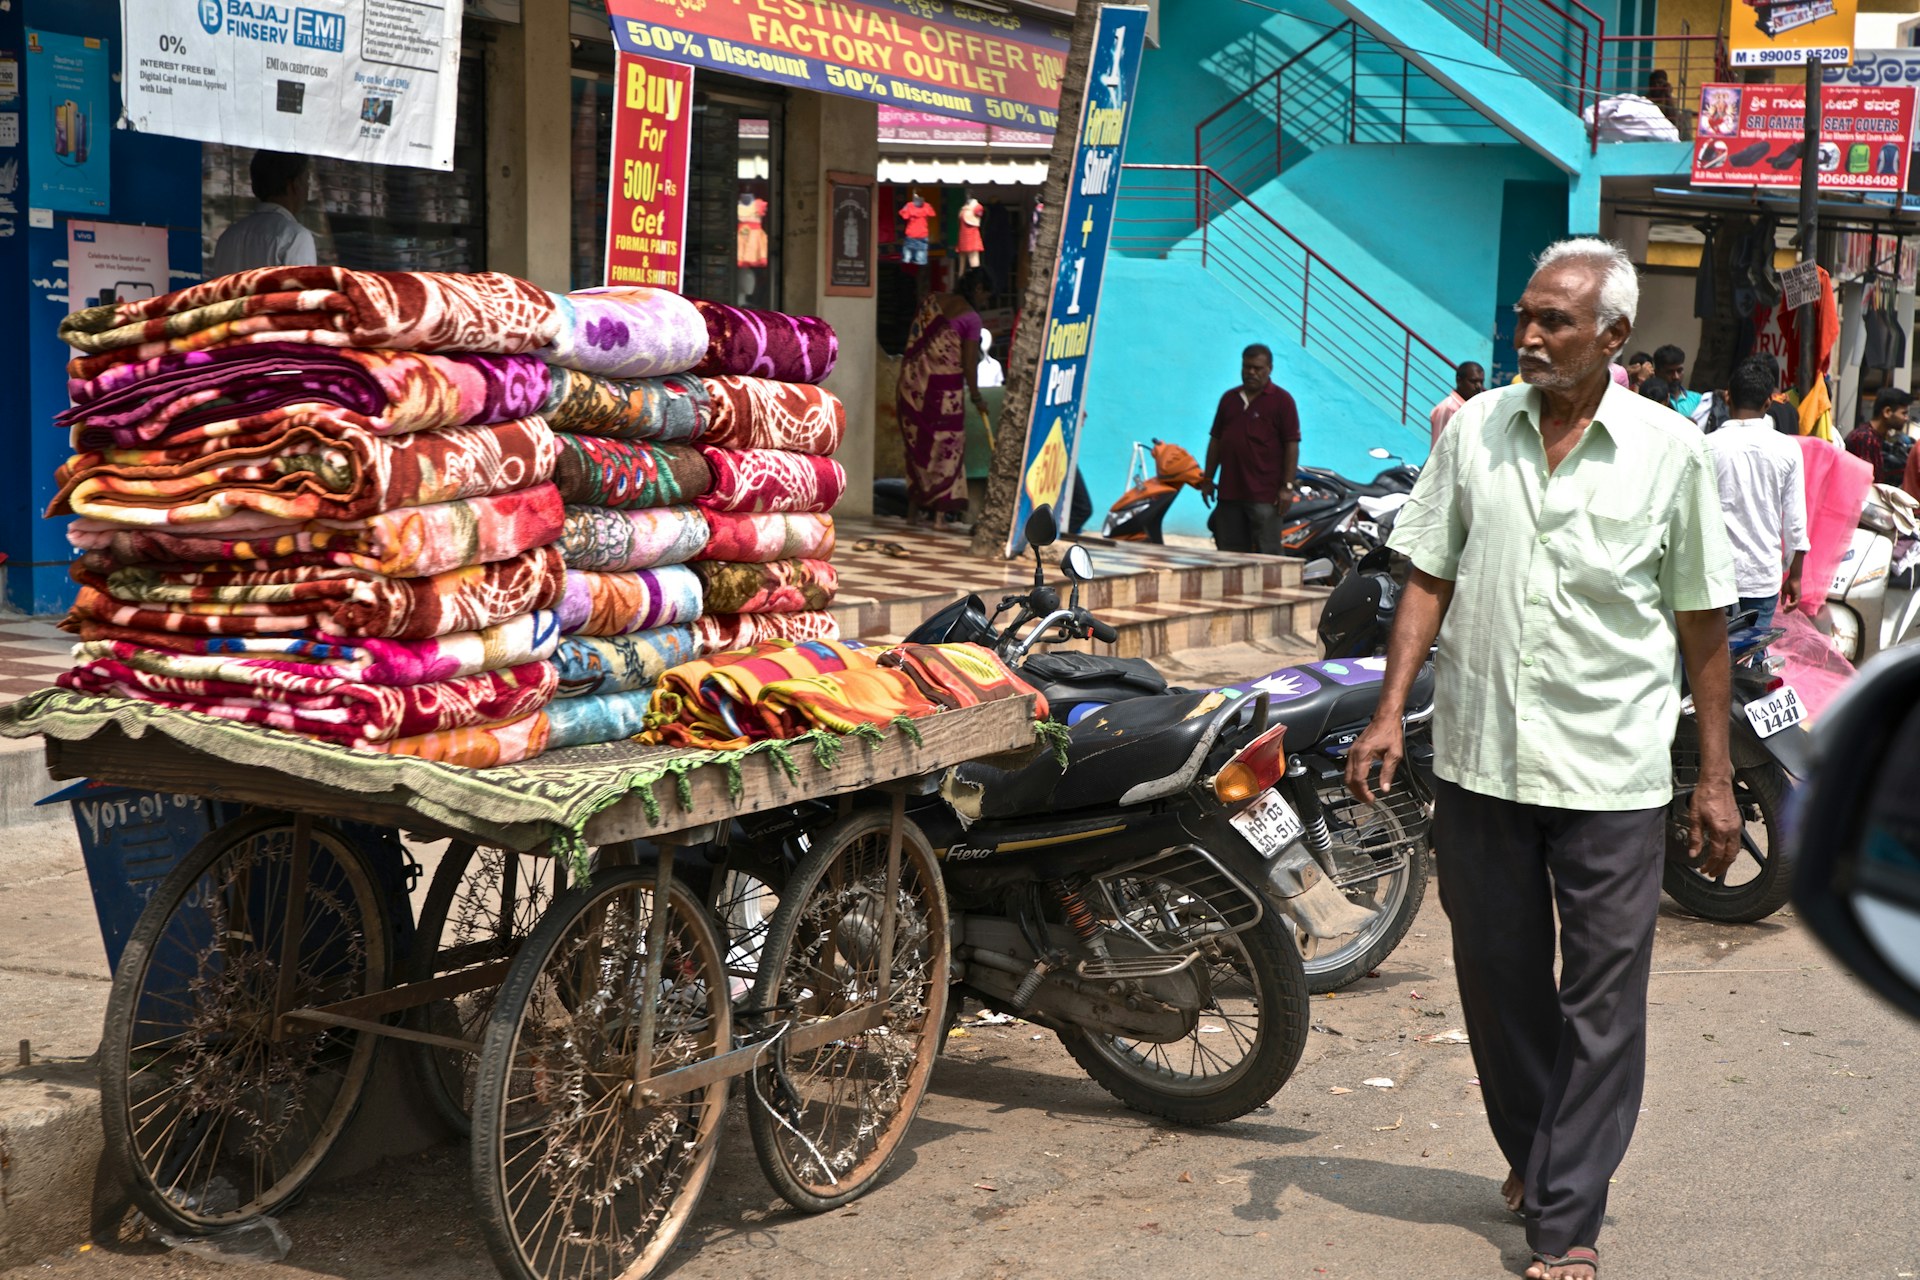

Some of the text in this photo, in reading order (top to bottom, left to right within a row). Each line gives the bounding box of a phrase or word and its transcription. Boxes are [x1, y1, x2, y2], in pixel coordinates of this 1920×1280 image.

[227, 0, 289, 24] BAJAJ
[227, 19, 288, 45] FINSERV
[297, 11, 343, 40] EMI
[732, 0, 1029, 72] ESTIVAL OFFER
[159, 34, 187, 55] 0%
[296, 33, 340, 50] FINANCE
[748, 13, 1008, 94] FACTORY OUTLET
[140, 58, 216, 76] INTEREST FREE EMI
[266, 57, 328, 78] EMI ON CREDIT CARDS
[1735, 52, 1747, 63] M
[1760, 50, 1802, 62] 99005
[1806, 48, 1848, 61] 95209
[139, 70, 161, 82] Digital
[162, 74, 177, 83] Card
[187, 77, 203, 87] Loan
[626, 20, 704, 58] 50%
[707, 37, 811, 79] Discount
[825, 63, 887, 96] 50%
[890, 79, 973, 113] Discount
[986, 97, 1036, 124] 50%
[140, 83, 173, 95] with Limit
[625, 62, 684, 121] Buy
[639, 117, 667, 152] For
[1083, 100, 1127, 148] Formal
[1747, 115, 1767, 129] SRI
[1824, 117, 1852, 131] SEAT
[1855, 119, 1899, 132] COVERS
[623, 158, 677, 203] 500/- Rs
[1080, 150, 1113, 197] Shirt
[631, 204, 665, 236] Get
[615, 234, 678, 256] FORMAL PANTS
[611, 264, 677, 286] FORMAL SHIRTS
[642, 256, 650, 269] &
[1045, 314, 1092, 362] Formal
[1045, 363, 1077, 407] Pant
[1751, 693, 1796, 723] KA 04 JB
[1764, 706, 1800, 733] 1441
[946, 843, 992, 862] Fiero
